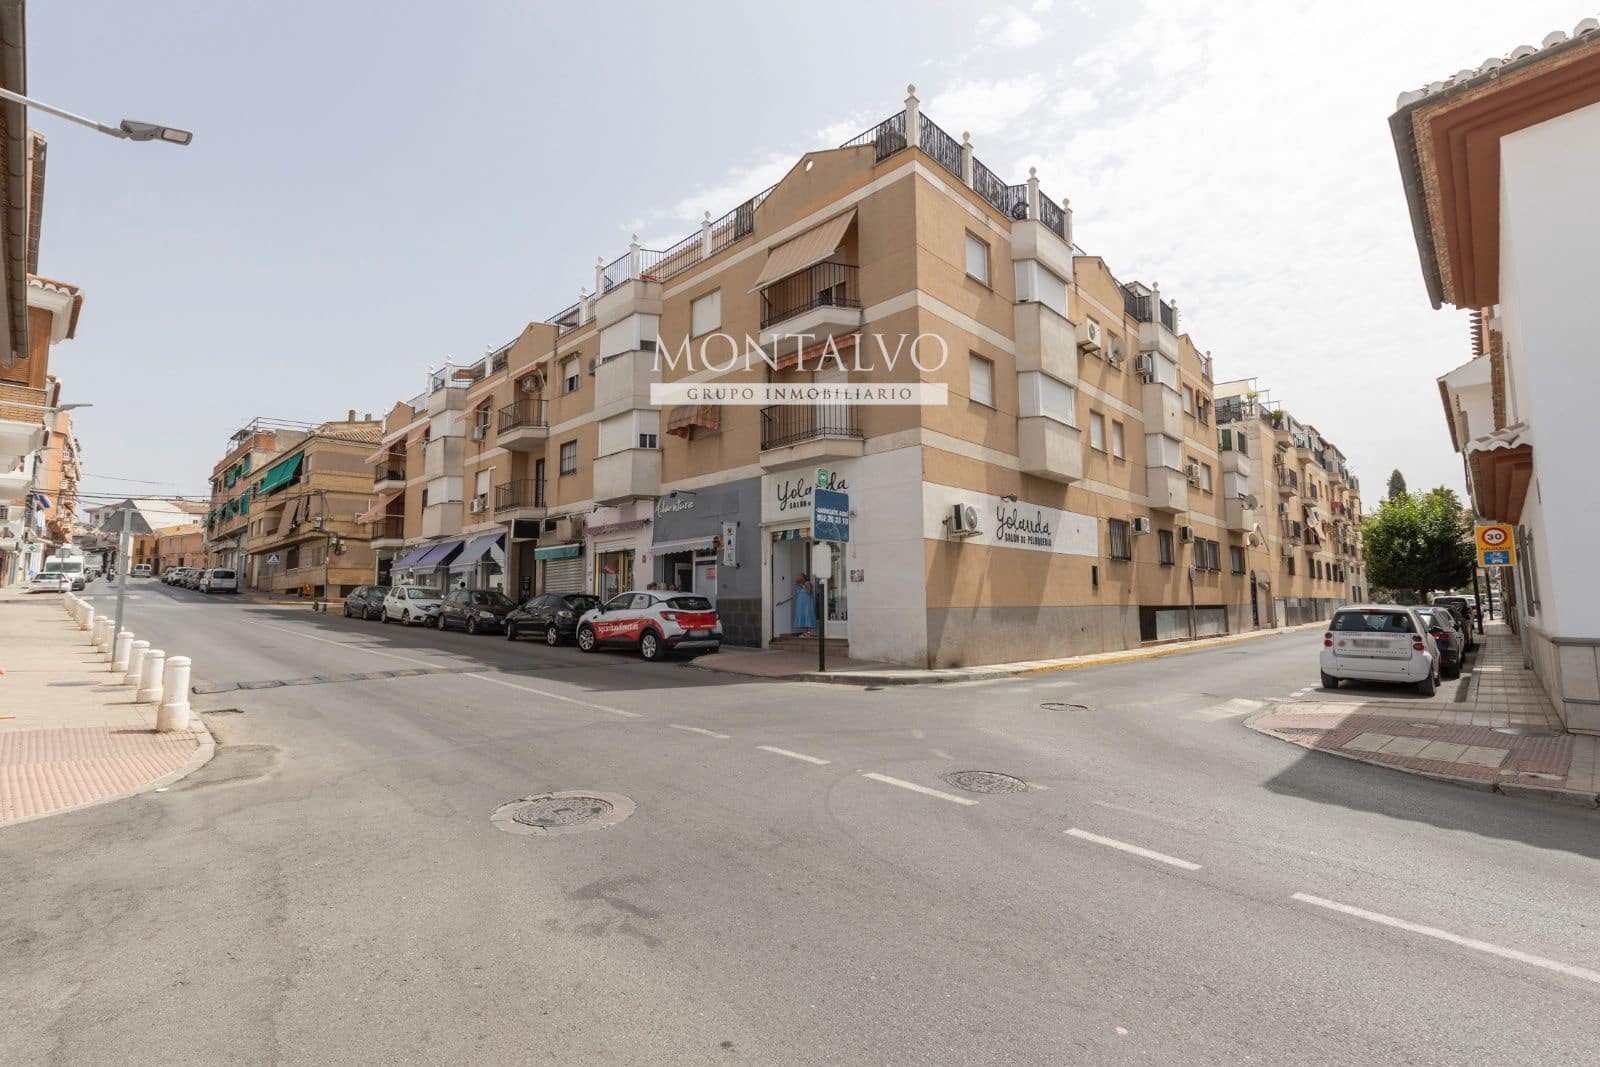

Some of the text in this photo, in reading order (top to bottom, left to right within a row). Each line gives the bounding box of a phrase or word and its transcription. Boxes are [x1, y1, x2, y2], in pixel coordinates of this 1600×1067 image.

[777, 471, 848, 511] Yolada
[996, 506, 1051, 540] Yolanda
[1487, 533, 1502, 541] 30
